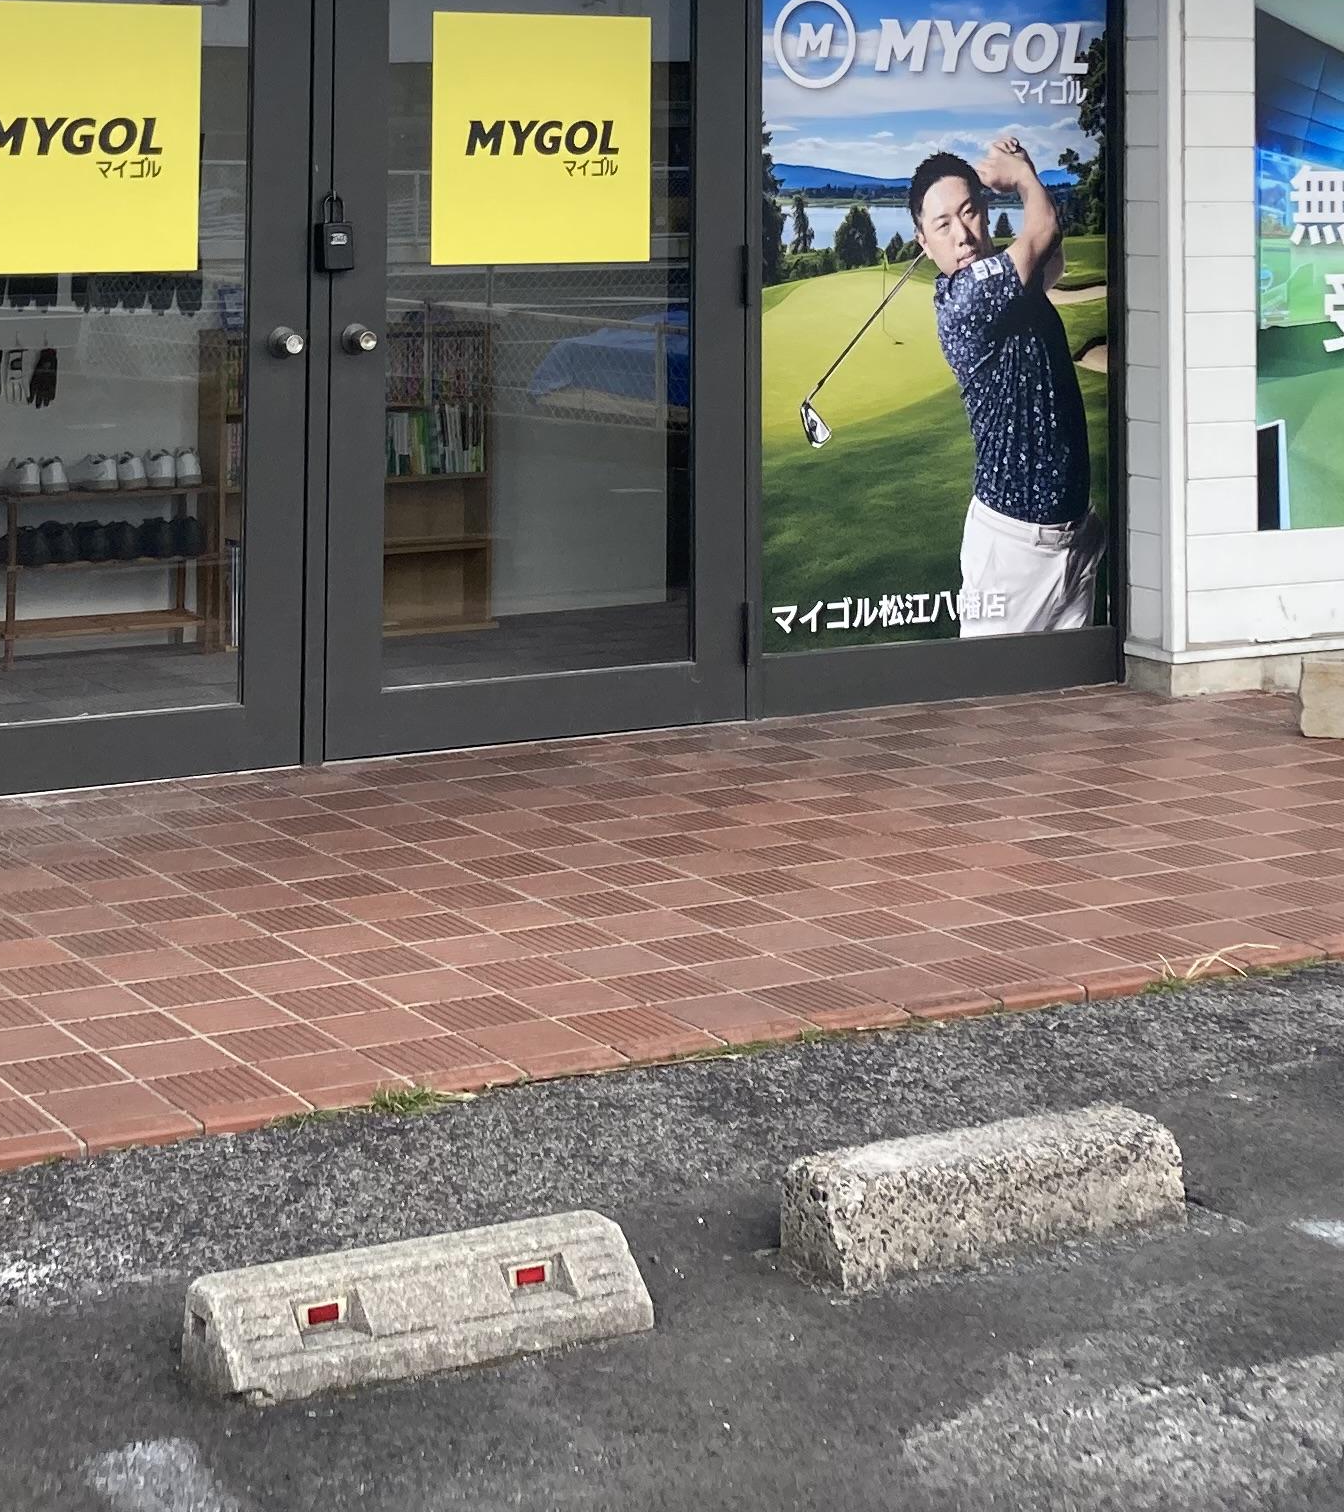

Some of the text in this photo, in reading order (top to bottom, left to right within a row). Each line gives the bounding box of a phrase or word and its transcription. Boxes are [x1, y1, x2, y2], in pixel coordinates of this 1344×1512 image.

[874, 18, 1090, 74] MYGOL
[1010, 75, 1089, 105] マイゴル
[464, 120, 620, 156] MYGOL
[96, 158, 162, 179] マイゴル
[563, 157, 619, 177] マイゴル
[771, 590, 1006, 634] マイゴル松江八幡店
